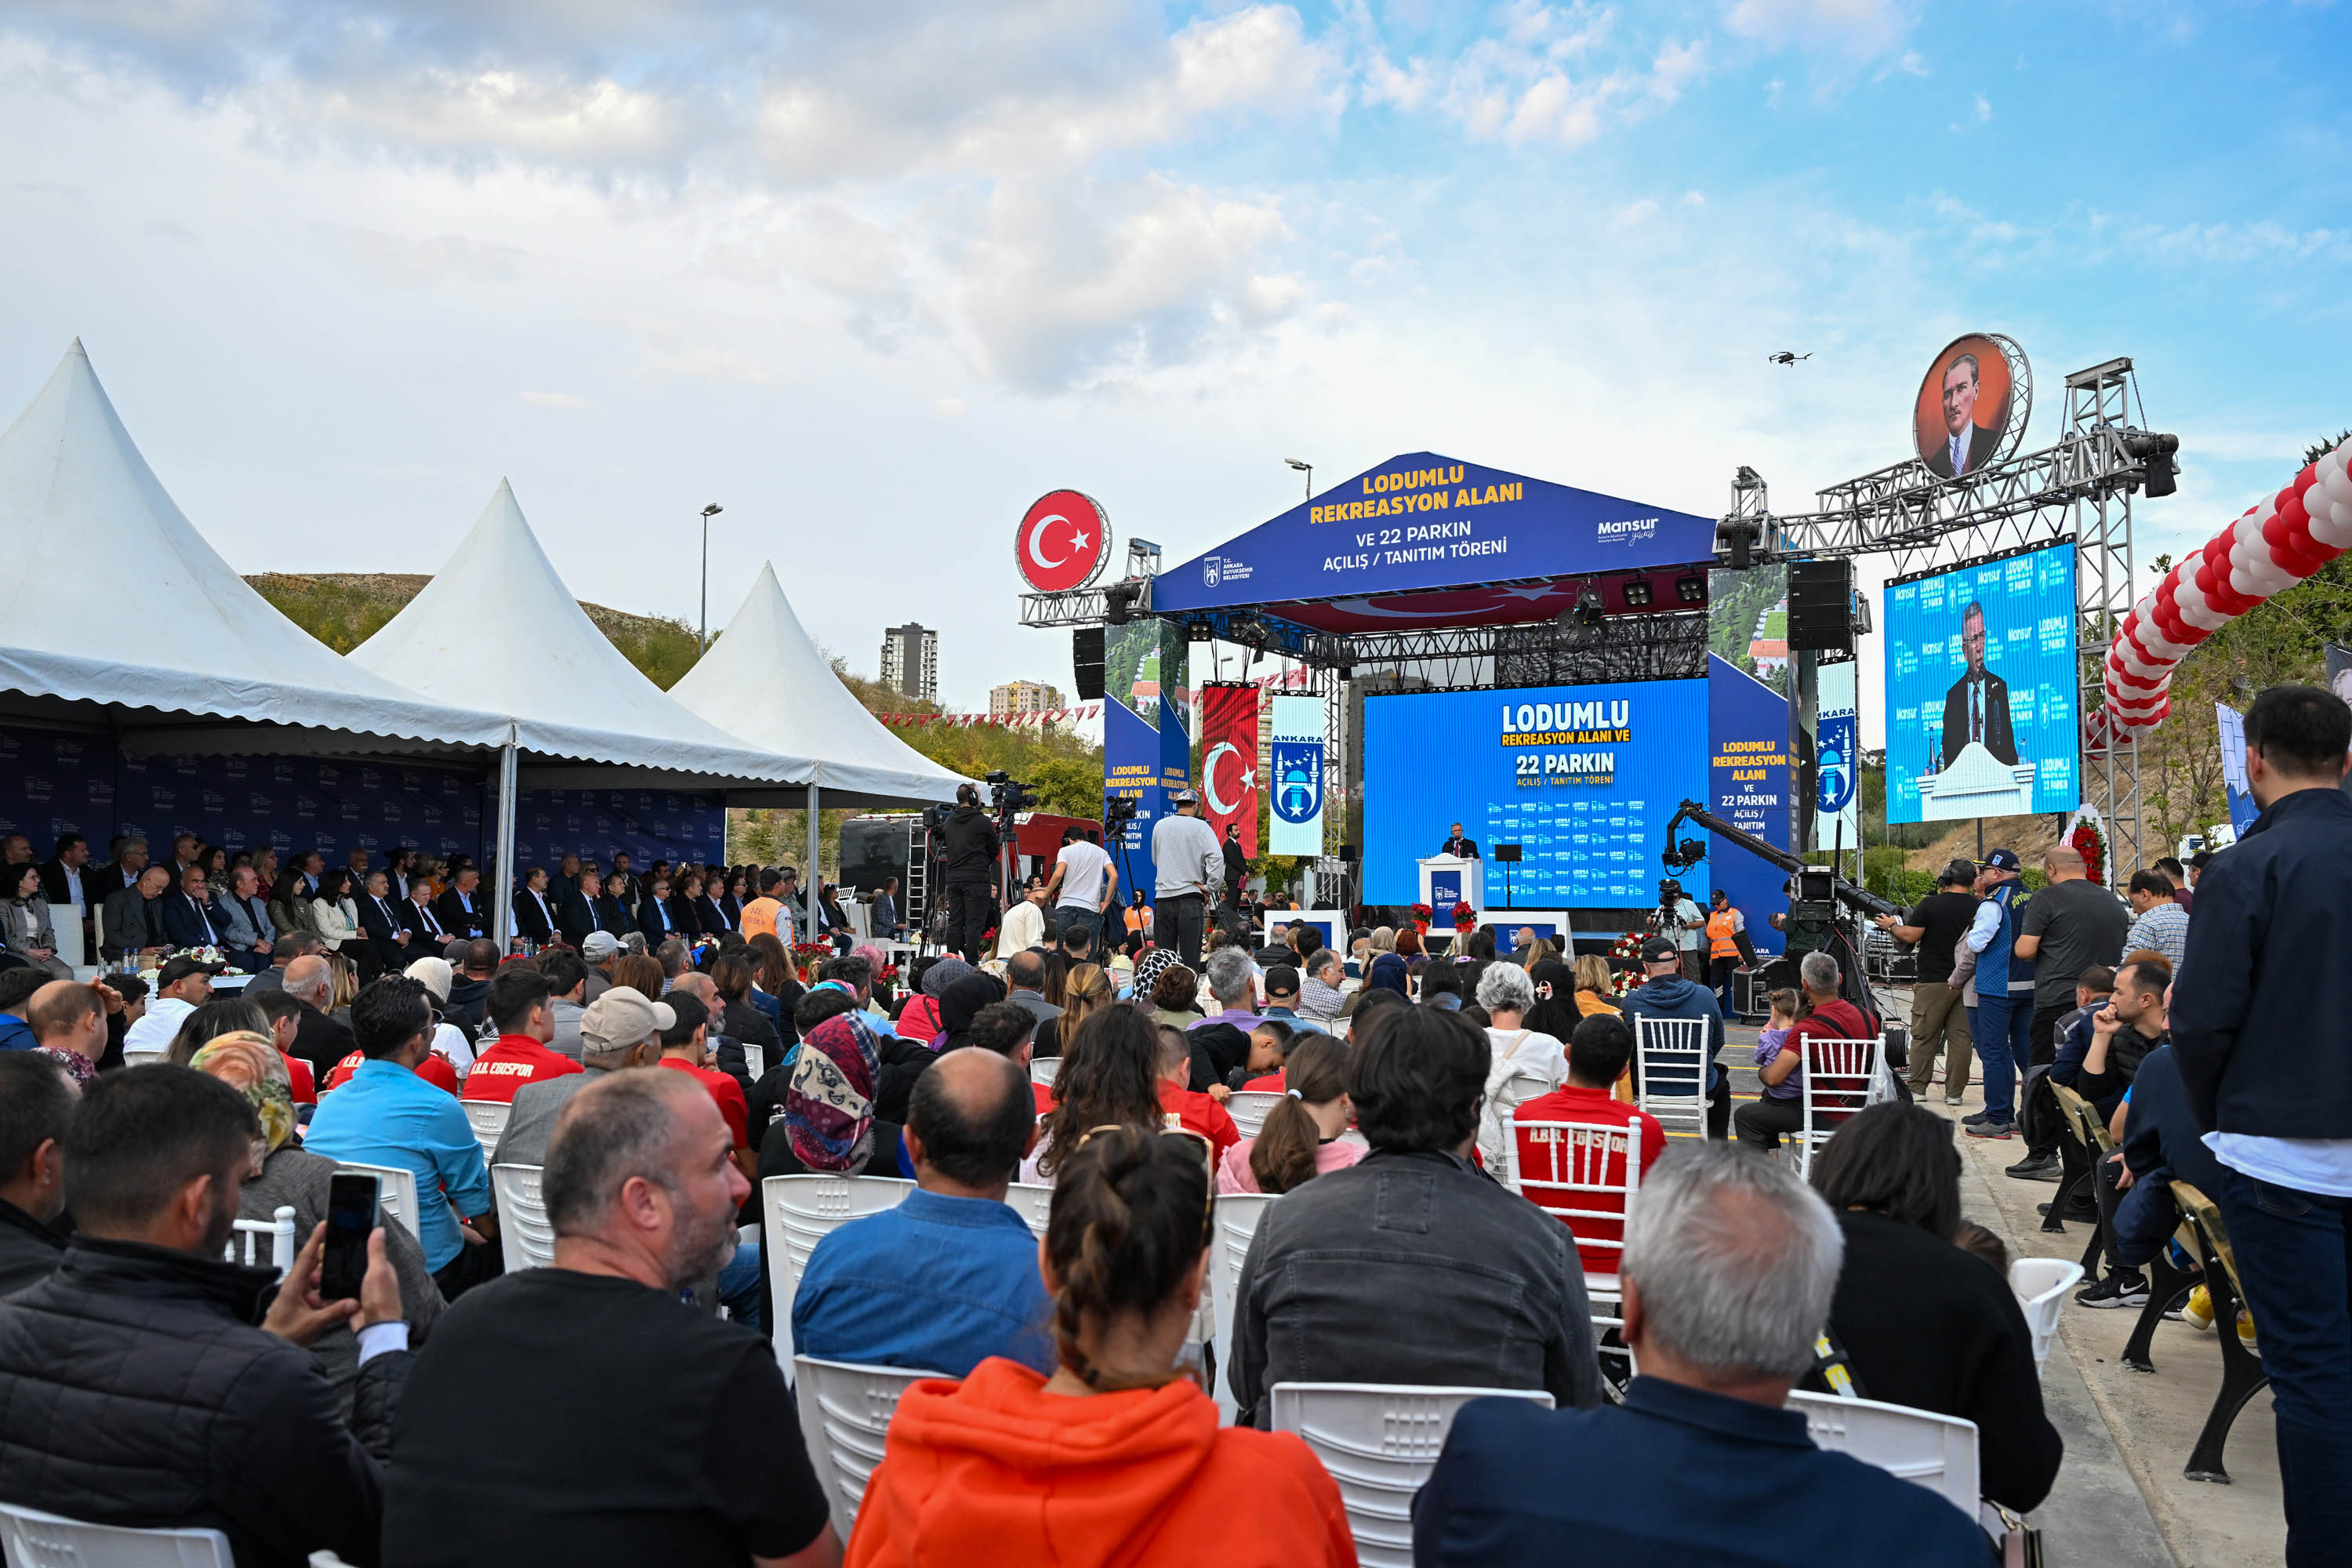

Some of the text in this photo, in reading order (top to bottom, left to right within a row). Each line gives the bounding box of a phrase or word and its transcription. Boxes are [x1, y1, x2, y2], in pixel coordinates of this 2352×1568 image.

[1363, 465, 1465, 495] LODUMLU
[1310, 482, 1523, 524] REKREASYON ALANI
[1598, 517, 1659, 535] Mansur
[1356, 521, 1471, 547] VE 22 PARKIN
[1323, 536, 1507, 573] AÇILIŞ / TANITIM TÖRENİ
[1502, 699, 1629, 733] LODUMLU
[1501, 729, 1631, 746] REKREASYON ALANI VE
[1722, 741, 1775, 753] LODUMLU
[1516, 752, 1614, 775] 22 PARKIN
[1712, 754, 1786, 767] REKREASYON
[1112, 765, 1149, 775] LODUMLU
[1164, 767, 1185, 778] LODUMLU
[1732, 769, 1766, 781] ALANI
[1105, 777, 1157, 787] REKREASYON
[1516, 777, 1541, 787] AÇILIŞ
[1550, 776, 1581, 785] TANITIM
[1584, 774, 1613, 785] TÖRENİ
[1744, 784, 1755, 793] VE
[1722, 794, 1777, 806] 22 PARKIN
[489, 1062, 534, 1077] EGOSPOR
